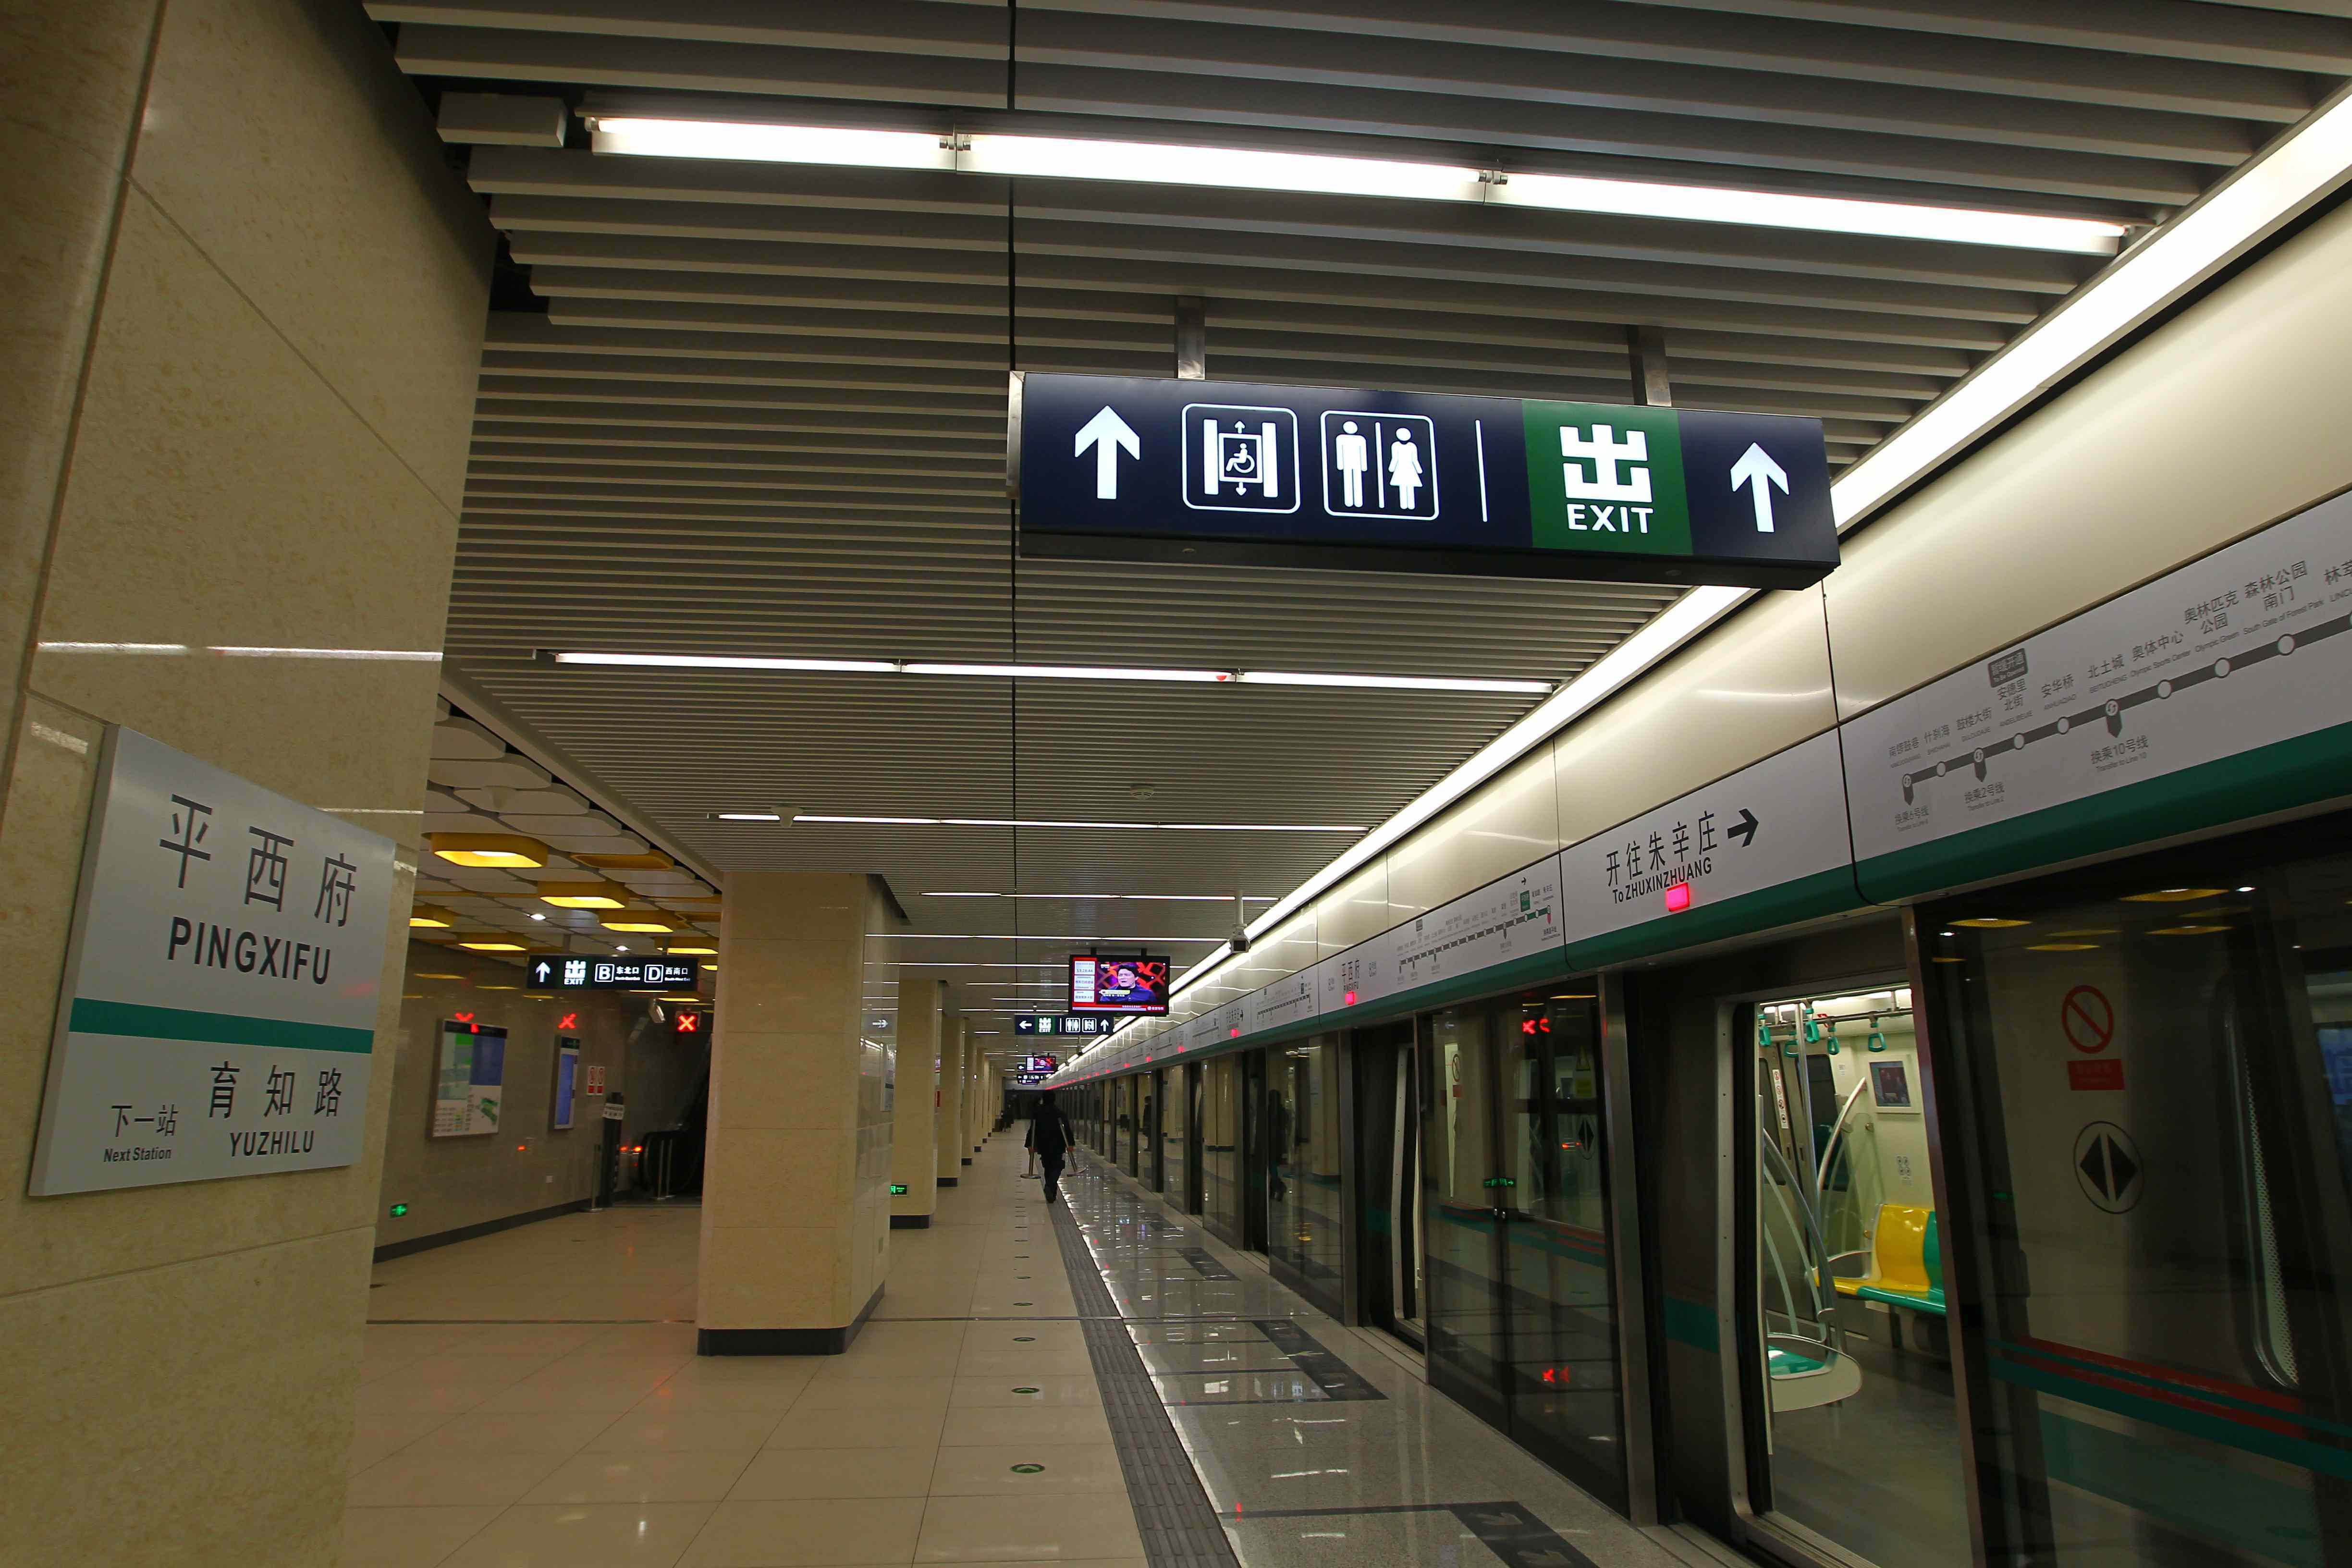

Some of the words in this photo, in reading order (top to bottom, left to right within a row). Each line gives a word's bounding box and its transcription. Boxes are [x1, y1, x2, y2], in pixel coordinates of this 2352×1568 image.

[1567, 503, 1654, 533] EXIT
[2244, 560, 2307, 599] 森林公园
[2184, 590, 2239, 625] 奥林匹克
[2264, 586, 2294, 611] 南门
[2201, 612, 2228, 634] 公园
[2132, 630, 2183, 662] 奥体中心
[2088, 654, 2125, 679] 北土城
[2042, 674, 2074, 698] 安华桥
[2090, 735, 2149, 764] 换乘10号线
[159, 794, 356, 927] 平西府
[1606, 810, 1718, 887] 开往朱辛庄
[1613, 888, 1624, 904] To
[1626, 857, 1712, 901] ZHUXINZHUANG
[167, 916, 330, 985] PINGXIFU
[599, 966, 611, 980] B
[648, 967, 661, 980] D
[208, 1061, 342, 1119] 育知路
[111, 1104, 178, 1138] 下一站
[103, 1147, 130, 1163] Next
[132, 1146, 171, 1161] Station
[229, 1130, 314, 1157] YUZHILU
